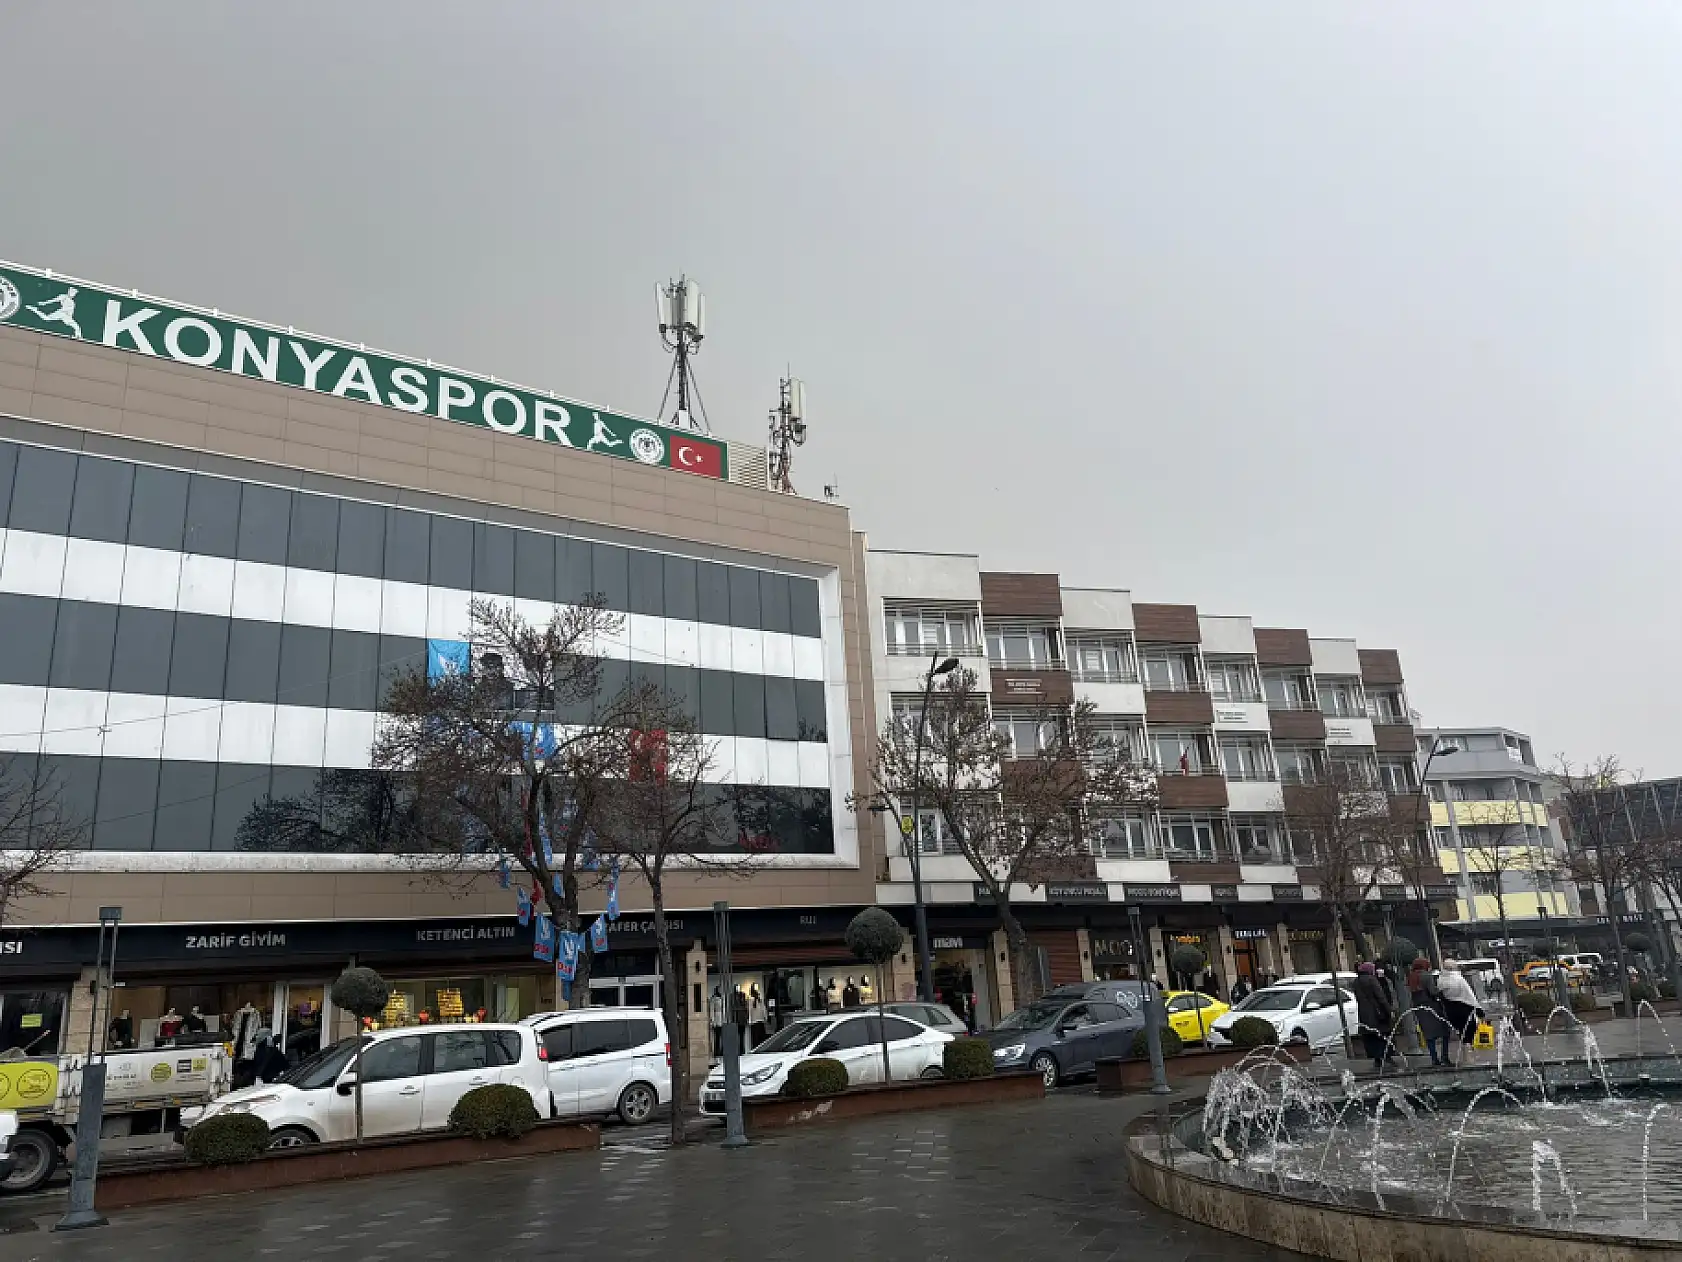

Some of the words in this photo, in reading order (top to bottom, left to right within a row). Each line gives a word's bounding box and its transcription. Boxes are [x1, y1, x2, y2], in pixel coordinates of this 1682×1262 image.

[102, 299, 574, 448] KONYASPOR
[416, 925, 474, 941] KETENCİ
[478, 926, 515, 939] ALTIN
[605, 920, 640, 934] AFER
[185, 932, 237, 949] ZARİF
[239, 930, 286, 947] GİYİM
